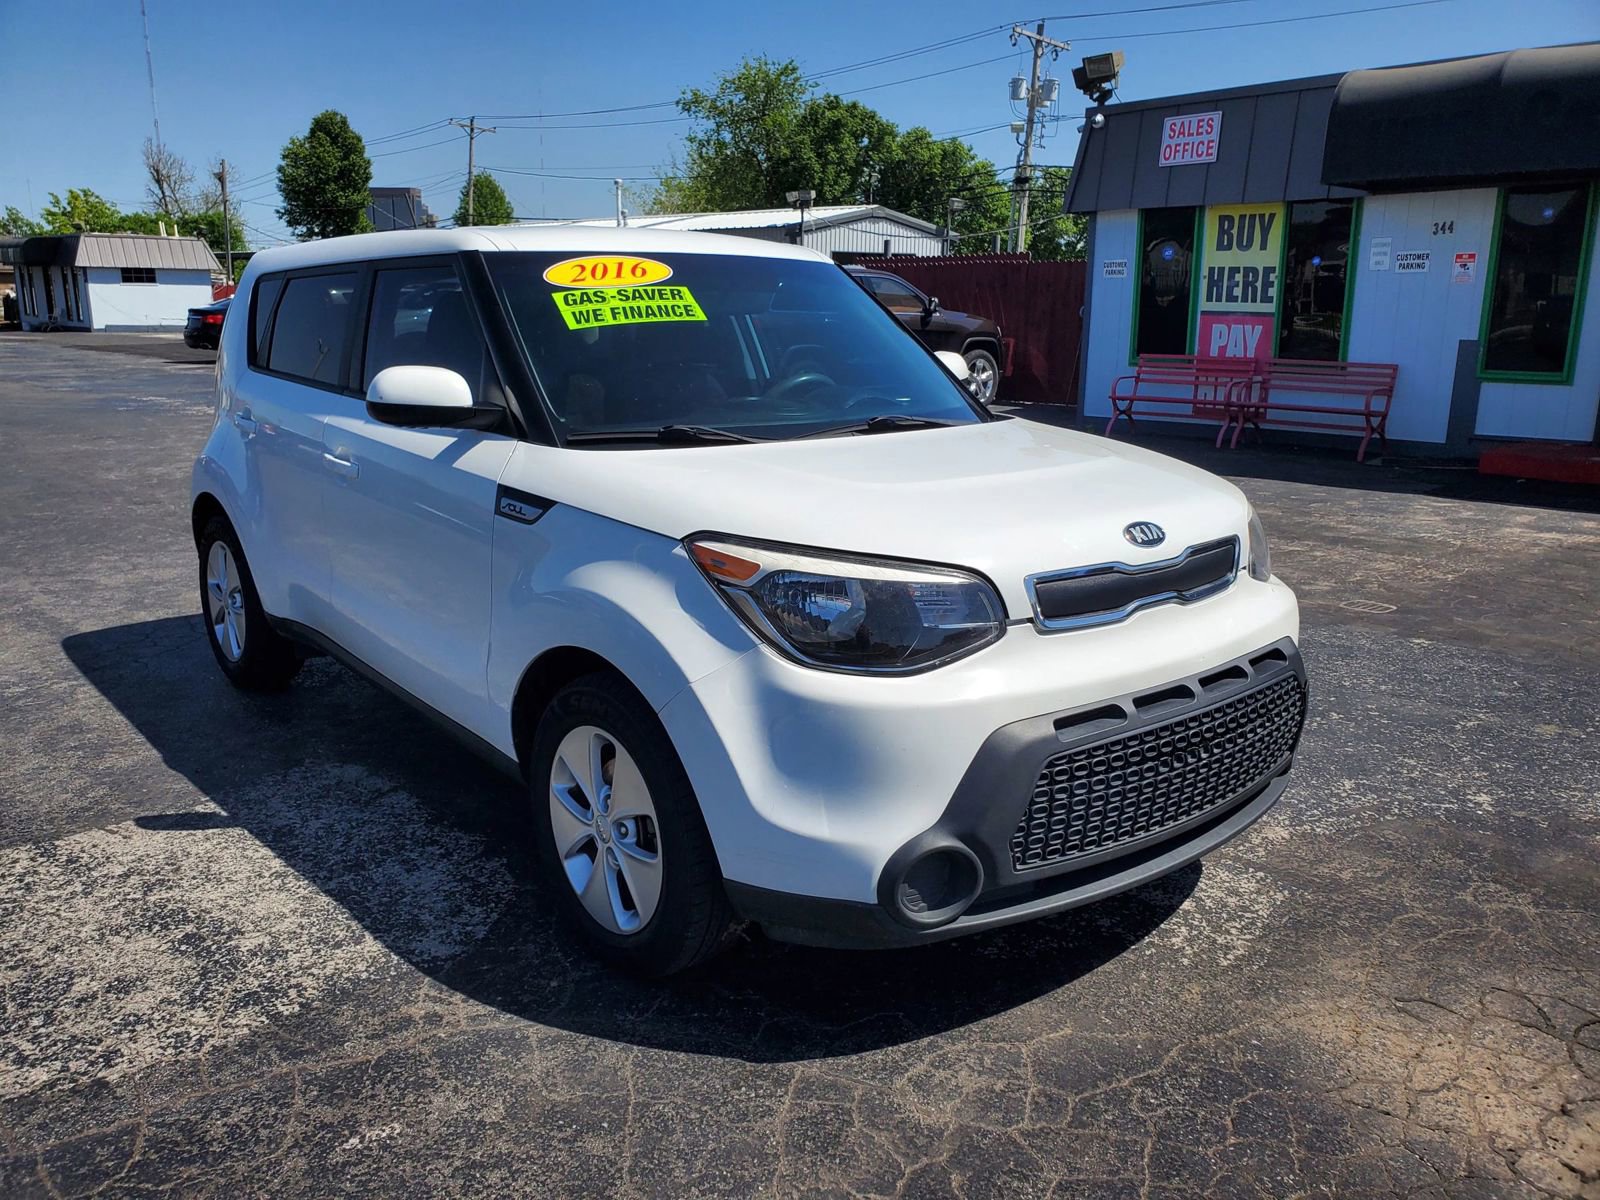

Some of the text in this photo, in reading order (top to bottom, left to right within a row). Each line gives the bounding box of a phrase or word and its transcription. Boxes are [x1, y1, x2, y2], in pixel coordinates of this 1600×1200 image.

[1168, 117, 1214, 140] SALES
[1163, 140, 1215, 161] OFFICE
[1216, 212, 1276, 252] BUY
[1432, 221, 1454, 235] 344
[1103, 261, 1127, 269] CUSTOMER
[1396, 253, 1430, 262] CUSTOMER
[1398, 262, 1426, 270] PARKING
[570, 261, 647, 283] 2016
[1206, 266, 1277, 303] HERE
[563, 288, 685, 307] GAS-SAVER
[571, 304, 696, 325] WE FINANCE
[1209, 323, 1263, 358] PAY
[1128, 524, 1164, 543] KIA
